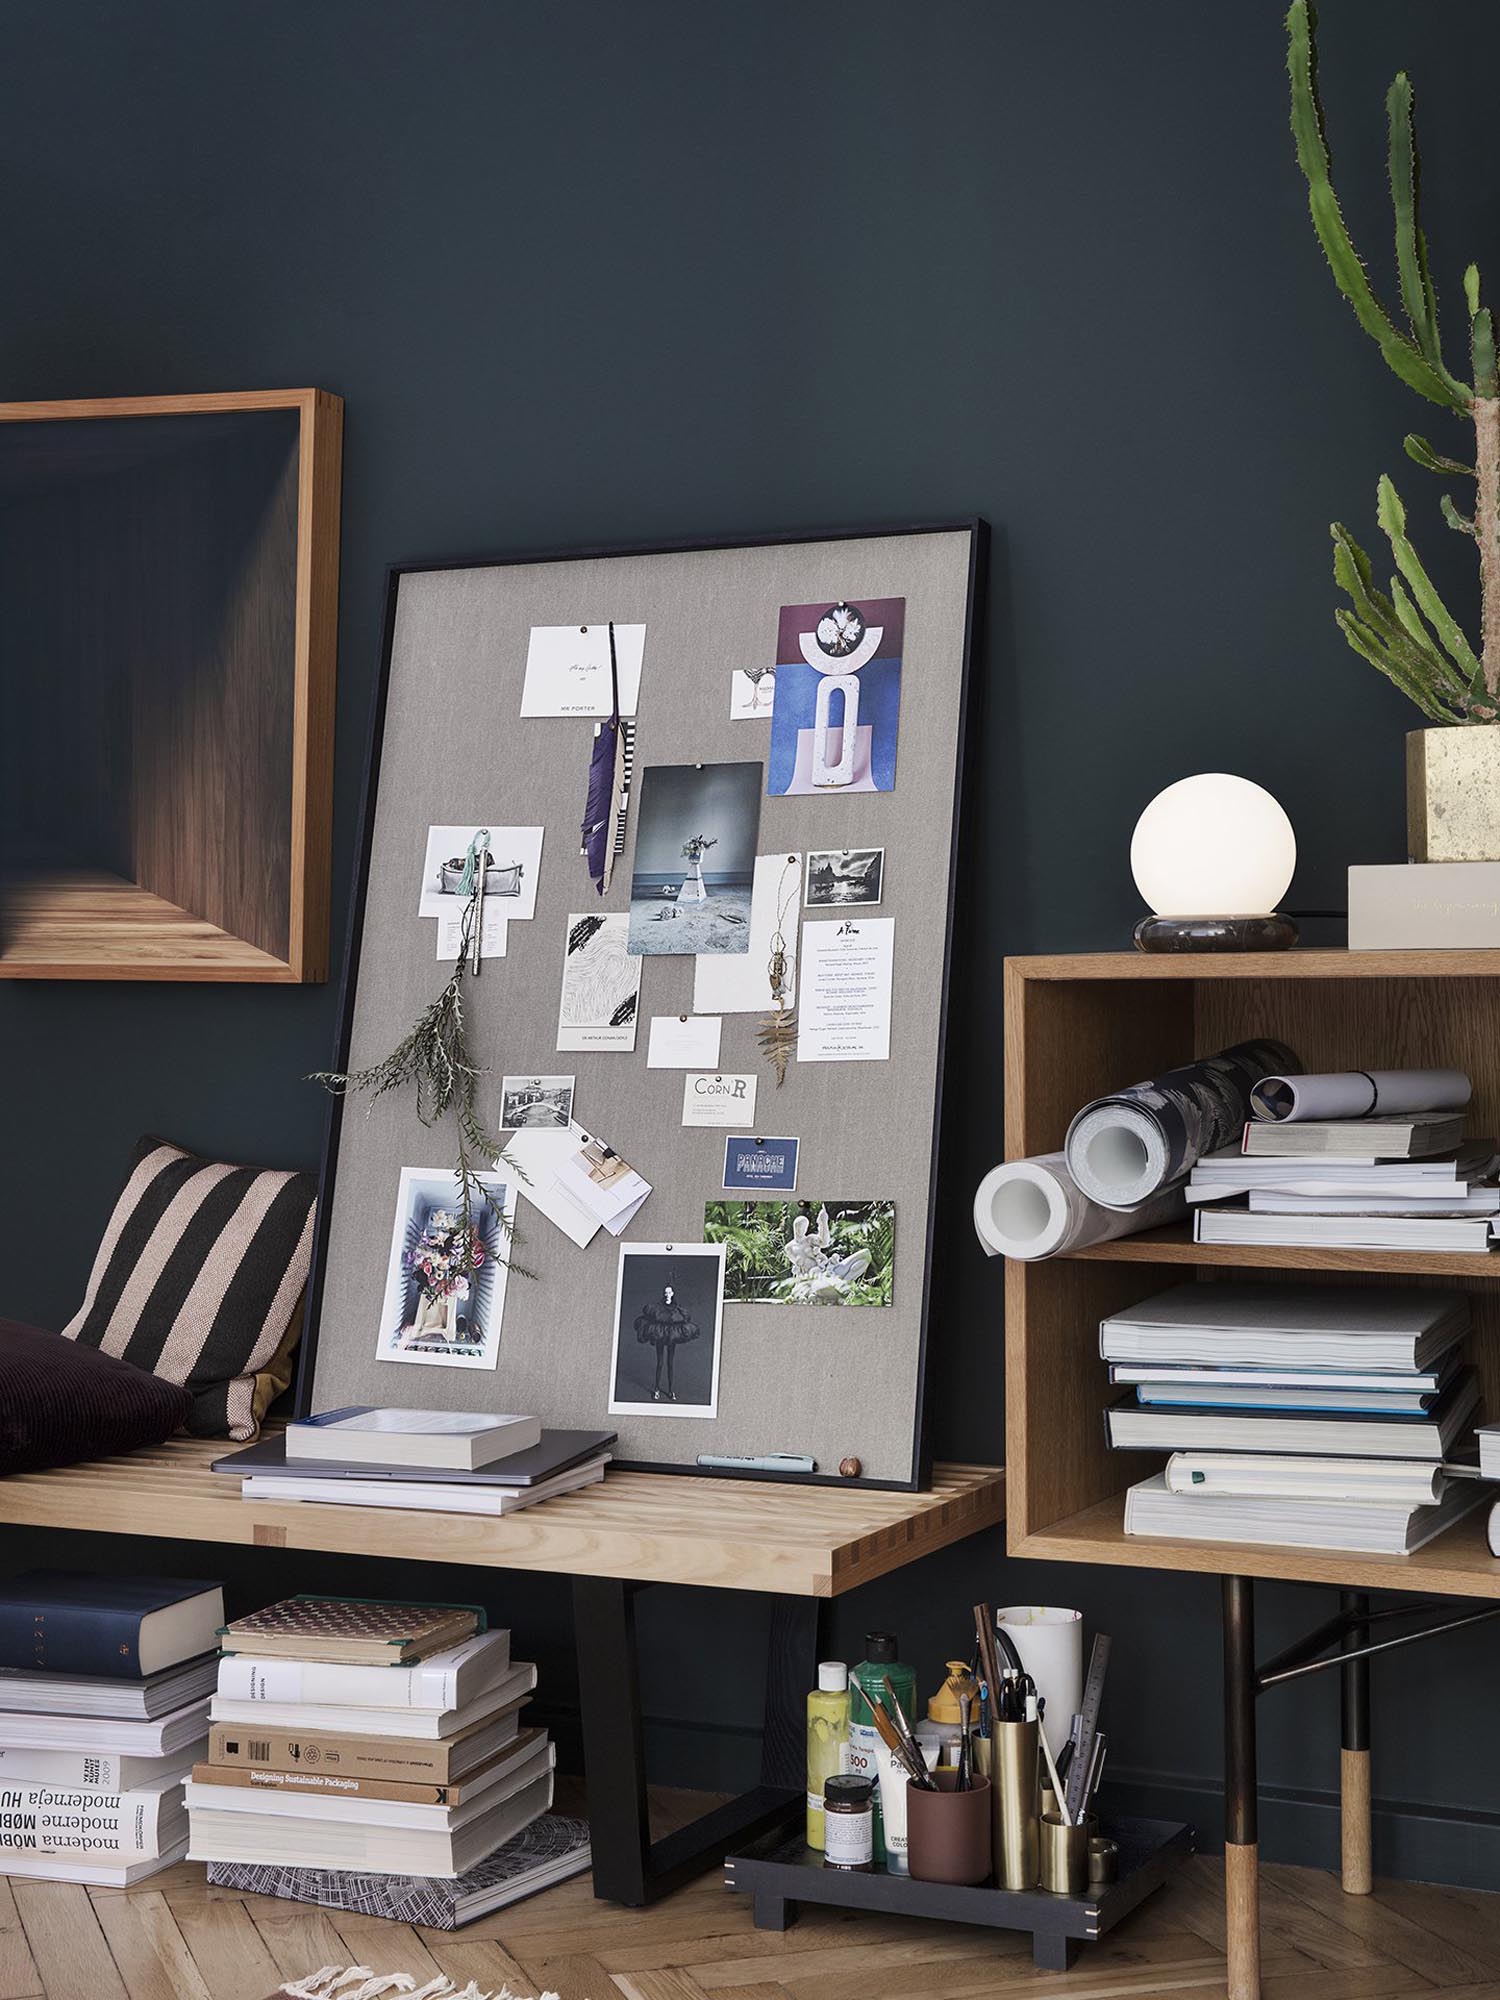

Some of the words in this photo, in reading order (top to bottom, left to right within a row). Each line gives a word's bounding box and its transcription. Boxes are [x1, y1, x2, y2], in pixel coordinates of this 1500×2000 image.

[737, 1153, 785, 1170] PANACHE
[850, 1754, 868, 1768] 500
[102, 1760, 110, 1785] 2009
[250, 1771, 284, 1784] Designing
[285, 1774, 324, 1785] Sustainable
[324, 1778, 359, 1790] Packaging
[28, 1788, 121, 1812] moderneja
[0, 1813, 36, 1830] MØB
[42, 1813, 119, 1833] moderne
[0, 1833, 37, 1850] MÖB
[42, 1834, 120, 1851] moderna
